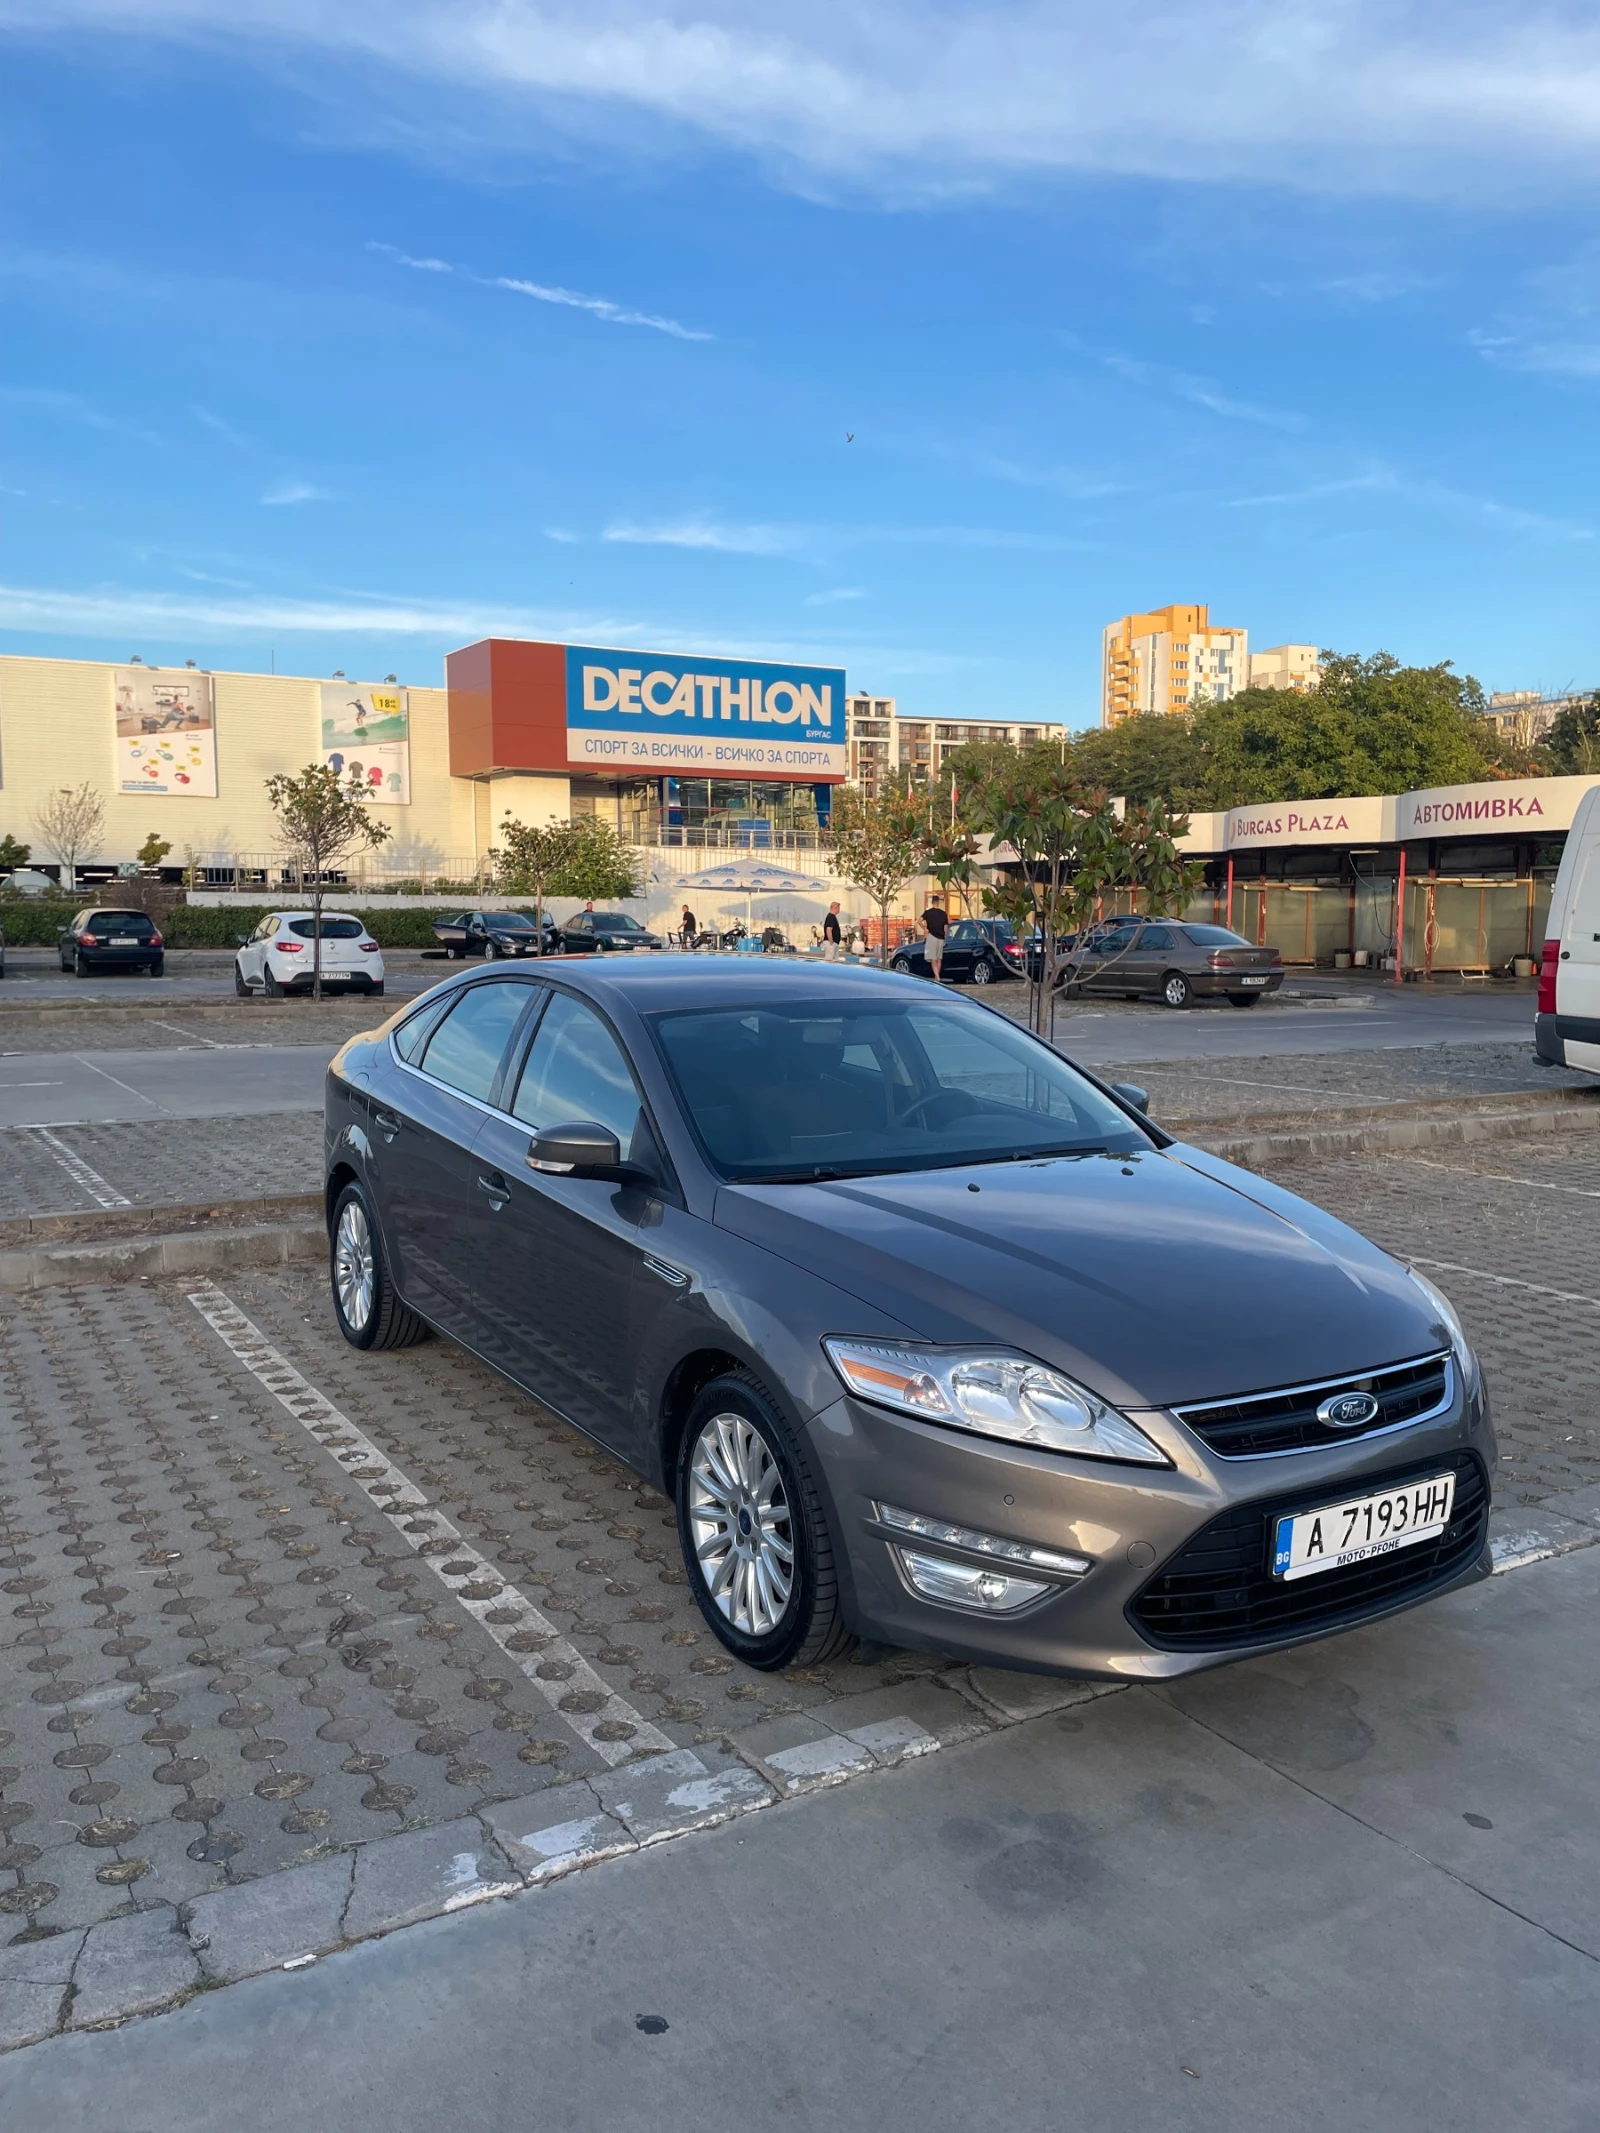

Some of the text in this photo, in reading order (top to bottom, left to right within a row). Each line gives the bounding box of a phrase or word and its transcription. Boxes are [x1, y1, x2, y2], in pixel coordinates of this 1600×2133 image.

[583, 665, 831, 726] DECATHLON
[805, 729, 832, 739] БУРГАС
[585, 739, 628, 755] СПОРТ
[631, 741, 648, 756] ЗА
[652, 743, 703, 759] ВСИЧКИ
[716, 747, 764, 762] ВСИЧКО
[767, 750, 782, 763] ЗА
[786, 751, 830, 765] СПОРТА
[1413, 796, 1544, 824] АВТОМИВКА
[1237, 814, 1349, 836] BURGAS PLAZA
[1341, 1400, 1367, 1419] Ford
[1306, 1518, 1324, 1558] A
[1276, 1551, 1290, 1565] BG
[1337, 1539, 1400, 1565] MOTO-PFOHE
